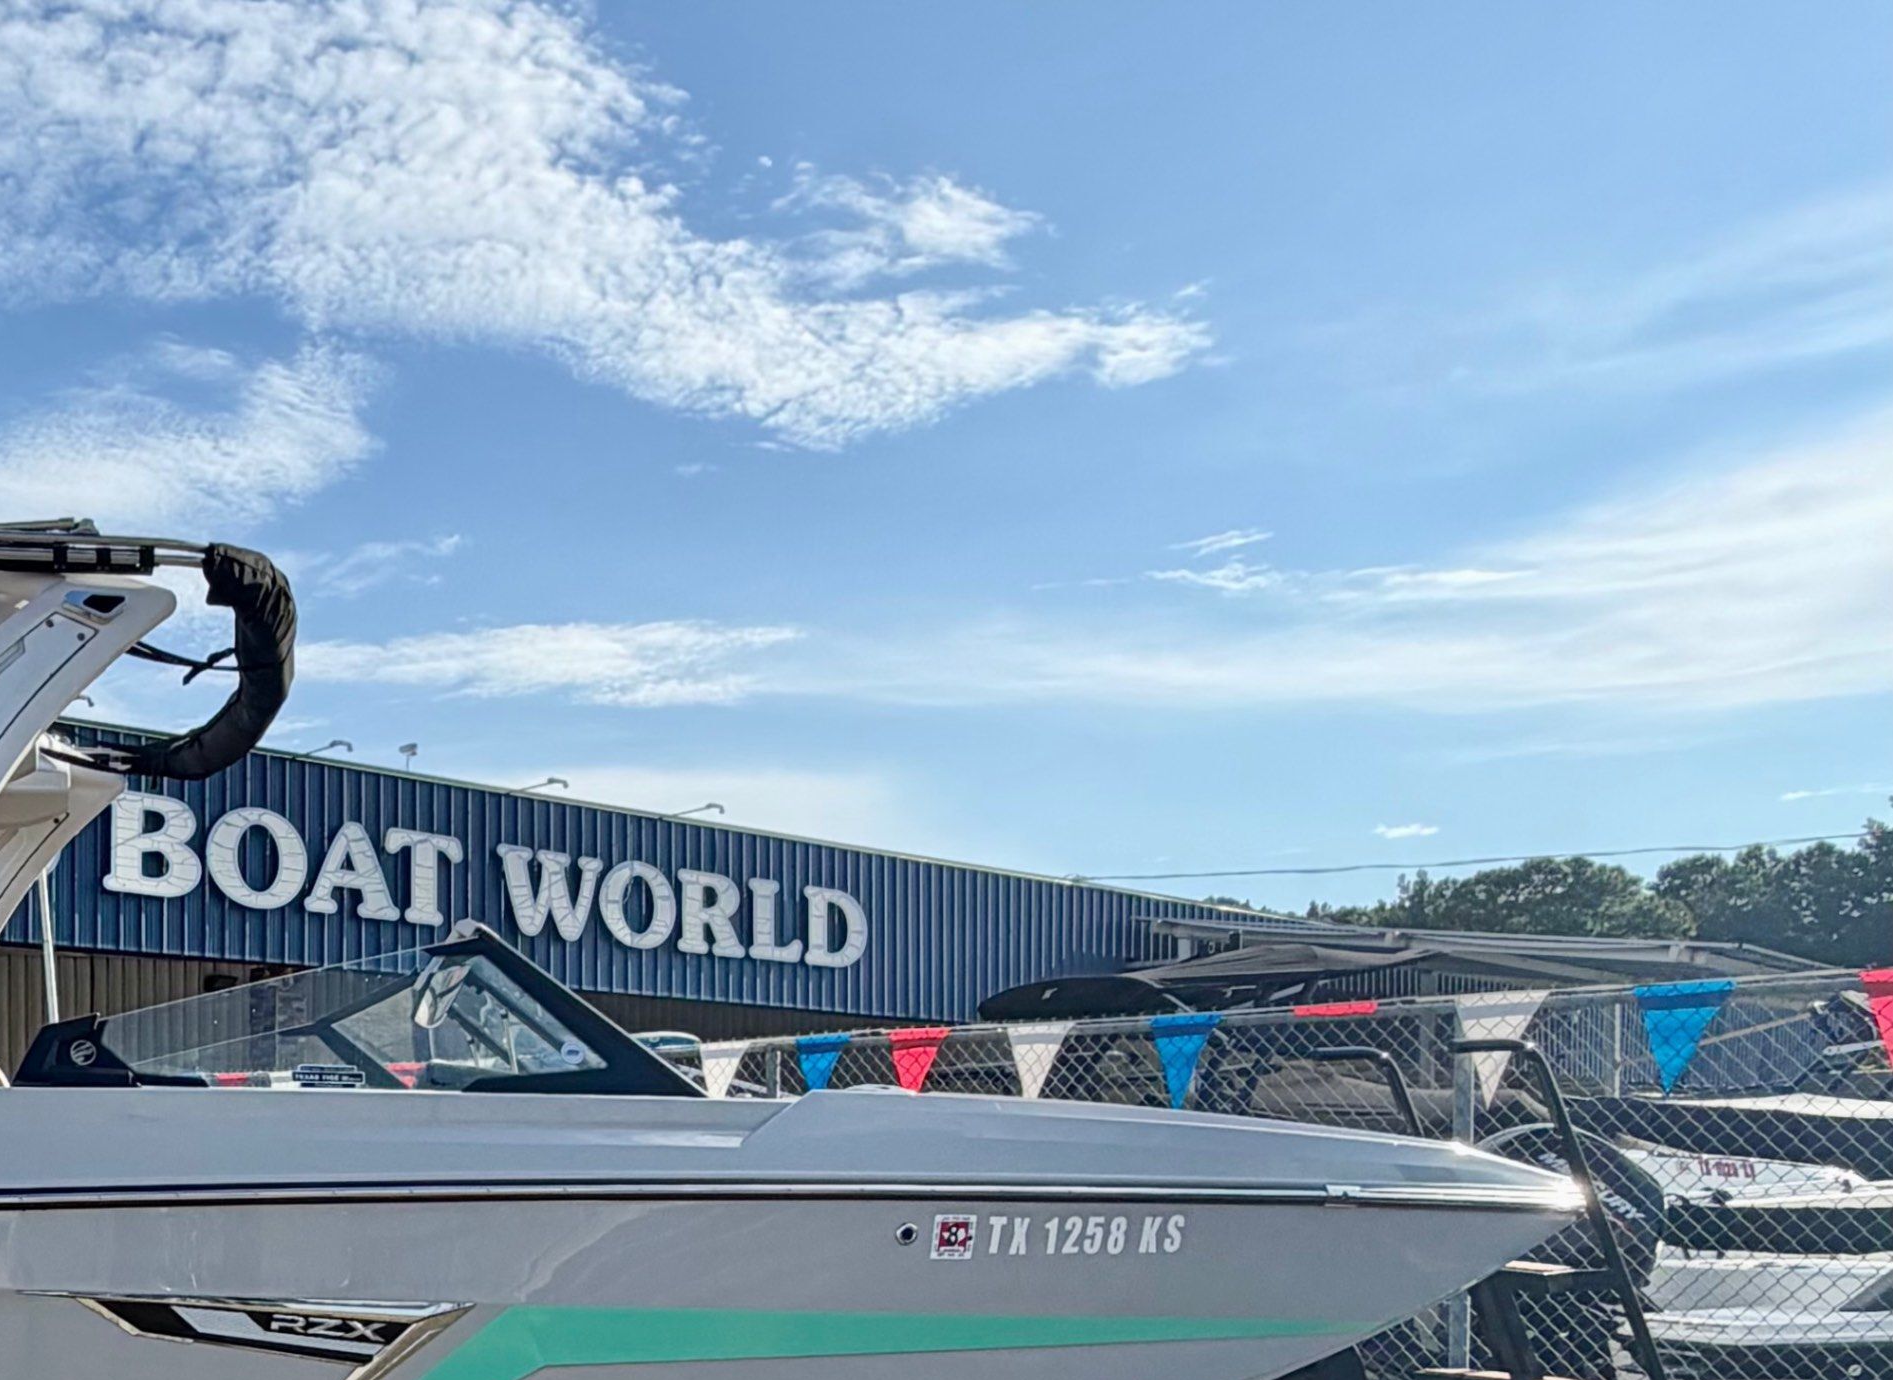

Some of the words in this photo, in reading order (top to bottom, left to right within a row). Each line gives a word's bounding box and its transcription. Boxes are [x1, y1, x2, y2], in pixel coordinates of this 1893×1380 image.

[103, 790, 463, 926] BOAT
[496, 842, 869, 968] WORLD
[988, 1215, 1031, 1256] TX
[1044, 1215, 1128, 1256] 1258
[1138, 1214, 1186, 1255] KS
[270, 1314, 387, 1342] RZX
